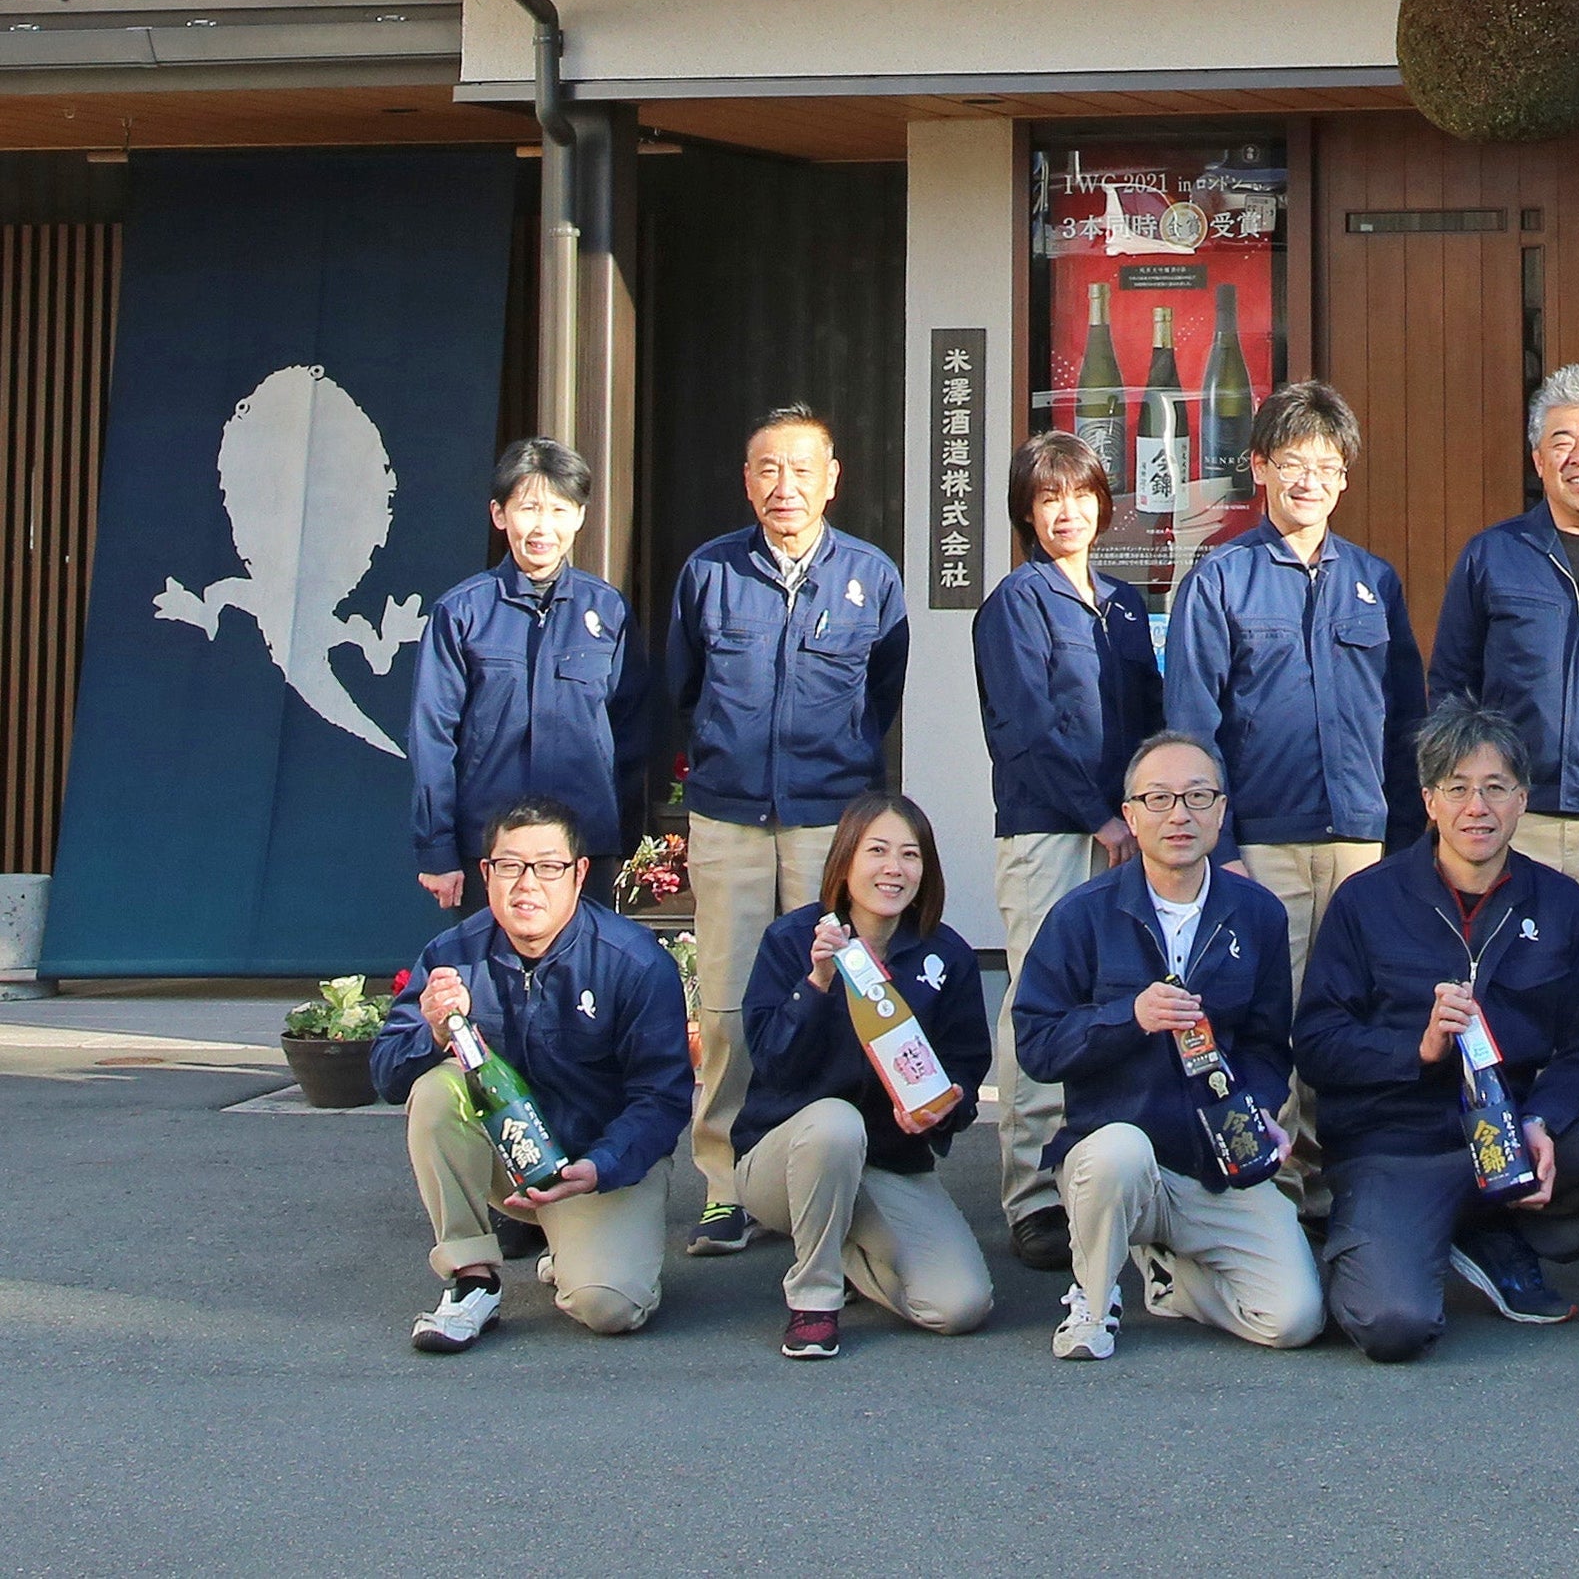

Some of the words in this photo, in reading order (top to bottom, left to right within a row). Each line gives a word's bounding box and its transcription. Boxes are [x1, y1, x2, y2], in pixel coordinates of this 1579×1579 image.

[1123, 173, 1168, 193] 2021
[1178, 176, 1191, 193] in
[940, 347, 973, 589] 米澤酒造株式会社
[501, 1117, 541, 1170] 今錦
[1222, 1110, 1259, 1159] 今錦
[1474, 1119, 1506, 1173] 今錦
